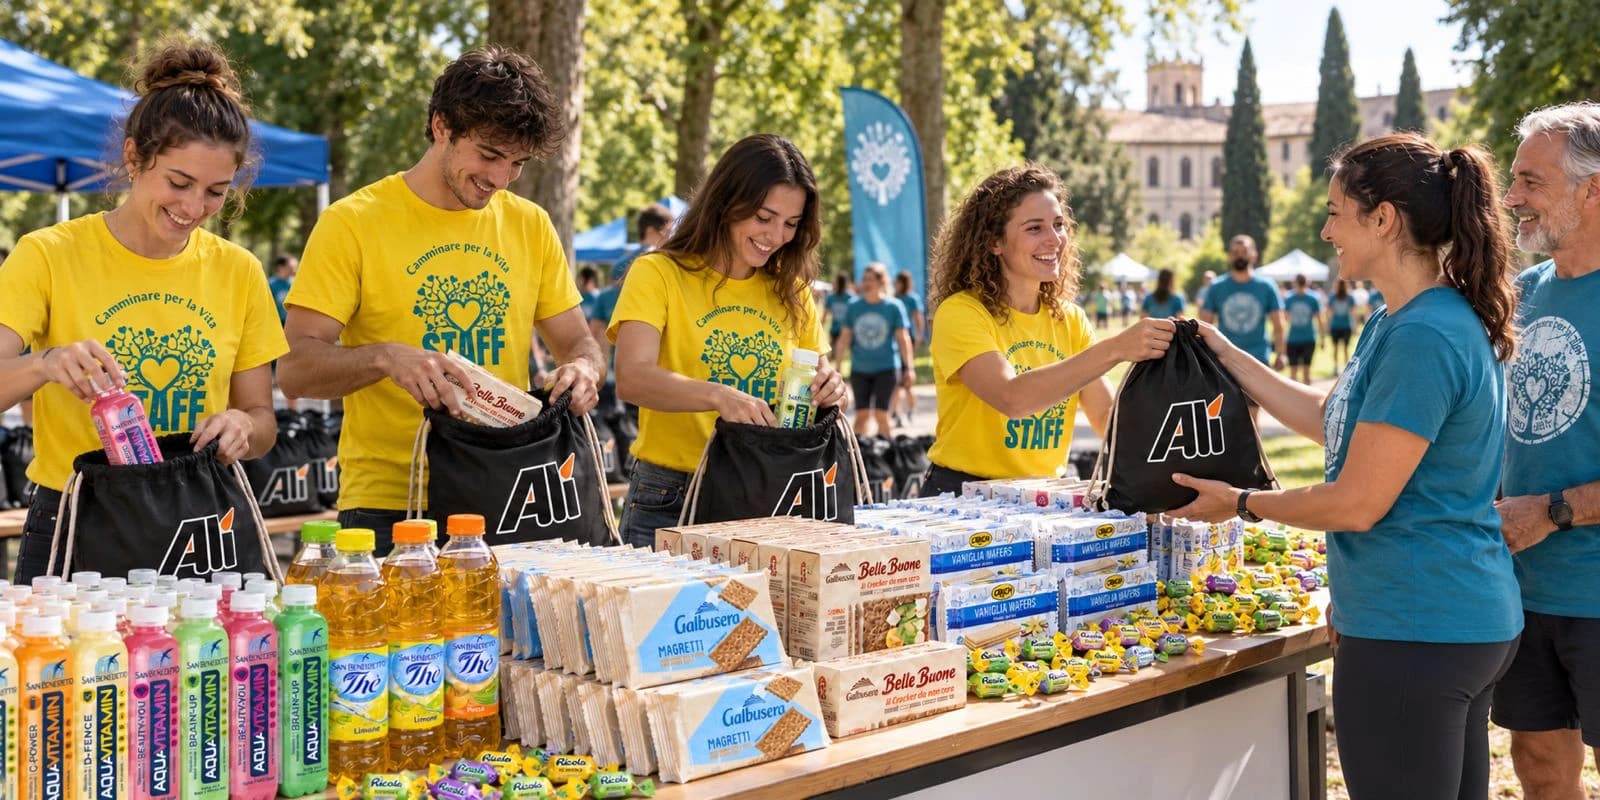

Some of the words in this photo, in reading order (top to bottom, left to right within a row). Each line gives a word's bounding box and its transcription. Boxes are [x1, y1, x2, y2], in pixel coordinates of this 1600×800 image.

[406, 243, 460, 275] Camminare
[464, 243, 480, 253] per
[483, 247, 492, 258] la
[495, 253, 510, 273] Vita
[95, 292, 161, 325] Camminare
[164, 293, 184, 304] per
[187, 299, 197, 312] la
[199, 307, 217, 330] Vita
[696, 305, 741, 328] Camminare
[744, 306, 757, 315] per
[759, 311, 767, 320] la
[768, 319, 782, 334] Vita
[492, 396, 525, 419] Buone
[1005, 418, 1064, 450] STAFF
[1147, 393, 1225, 462] Ali
[259, 463, 310, 506] Ali
[496, 452, 581, 534] Ali
[771, 462, 837, 521] Ali
[158, 507, 237, 576] Ali
[952, 551, 985, 566] VANIGLIA
[986, 546, 1013, 560] WAFERS
[858, 561, 887, 580] Belle
[887, 557, 921, 575] Buone
[674, 611, 740, 635] Galbusera
[974, 602, 1008, 618] VANIGLIA
[1008, 597, 1037, 612] WAFERS
[658, 640, 704, 658] MAGRETTI
[846, 688, 878, 702] Galbusera
[882, 672, 915, 696] Belle
[916, 666, 956, 688] Buone
[254, 668, 265, 772] AQUAVITAMIN
[291, 680, 300, 731] BRAIN-UP
[307, 661, 319, 761] AQUAVITAMIN
[414, 715, 438, 724] Limone
[722, 704, 786, 727] Galbusera
[189, 695, 197, 748] BRAIN-UP
[205, 674, 217, 779] AQUAVITAMIN
[353, 726, 381, 735] Limone
[29, 725, 38, 772] C-POWER
[84, 714, 92, 765] D-FENCE
[100, 689, 113, 798] AQUAVITAMIN
[153, 684, 167, 791] AQUAVITAMIN
[708, 731, 751, 750] MAGRETTI
[556, 757, 586, 767] Ricola
[370, 778, 402, 788] Ricola
[513, 782, 542, 791] Ricola
[601, 774, 628, 785] Ricola
